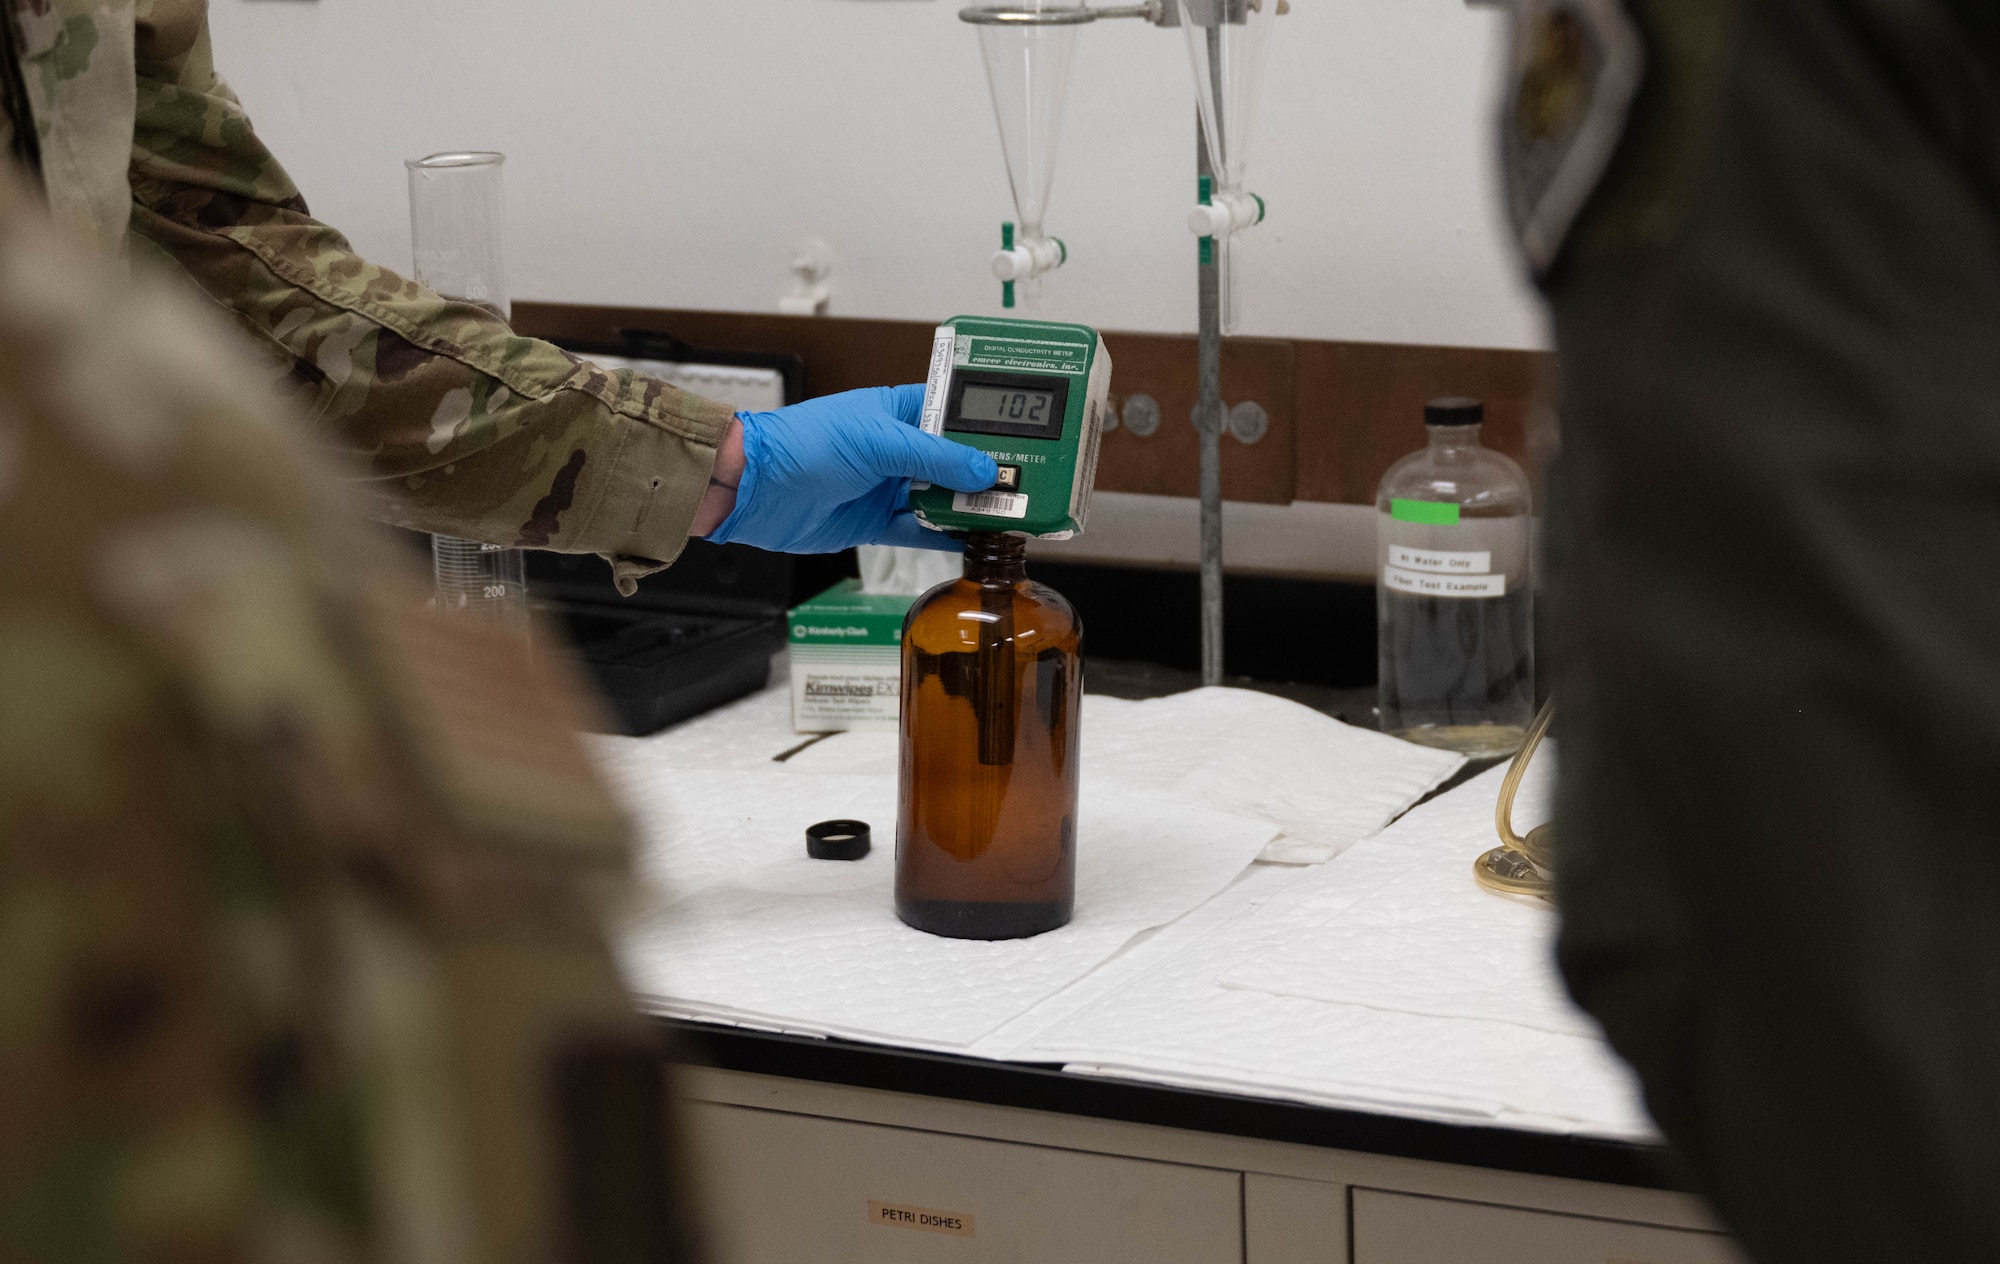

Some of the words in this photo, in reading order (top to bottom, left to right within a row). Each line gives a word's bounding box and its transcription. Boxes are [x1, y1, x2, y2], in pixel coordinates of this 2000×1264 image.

[1007, 346, 1051, 355] CONDUCTIVITY
[1053, 349, 1073, 357] METER
[999, 393, 1047, 421] 102
[1000, 470, 1007, 480] C
[1415, 555, 1442, 566] Water
[1449, 558, 1470, 568] Only
[1393, 574, 1413, 585] Fiber
[1420, 580, 1440, 589] Test
[1446, 582, 1488, 591] Example
[483, 585, 505, 598] 200
[808, 625, 868, 637] Kimberly-Clark
[806, 681, 873, 696] Kimwipes
[882, 1208, 915, 1223] PETRI
[920, 1214, 962, 1230] DISHES
